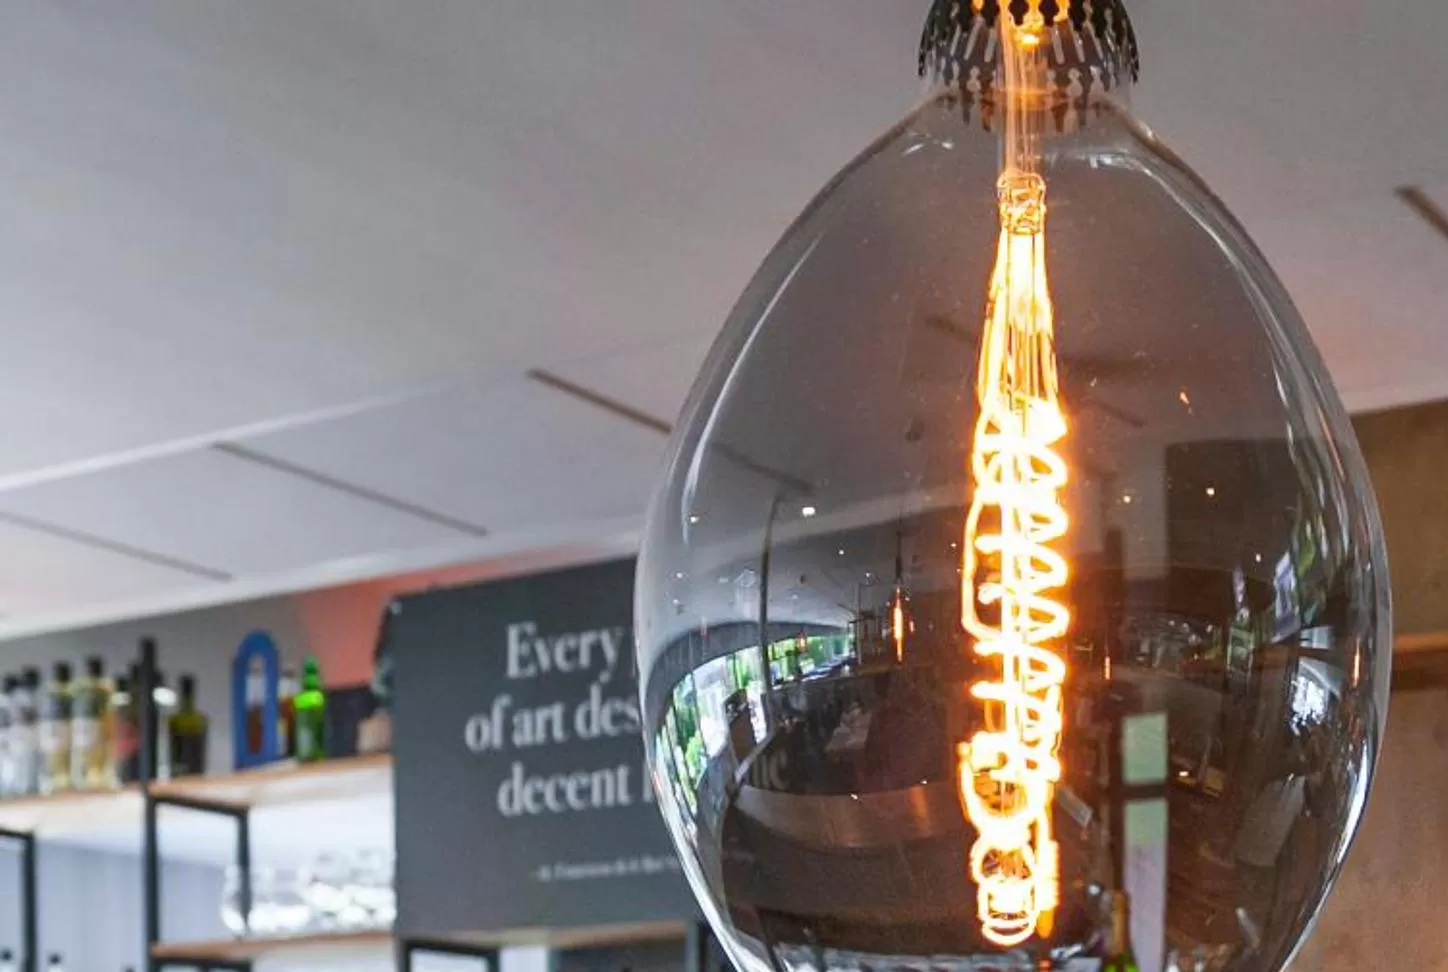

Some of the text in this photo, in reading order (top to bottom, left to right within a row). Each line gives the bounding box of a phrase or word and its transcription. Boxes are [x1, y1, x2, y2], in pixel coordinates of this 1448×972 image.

[506, 620, 625, 683] Every
[464, 693, 511, 752] of
[512, 700, 568, 748] art
[496, 760, 633, 818] decent
